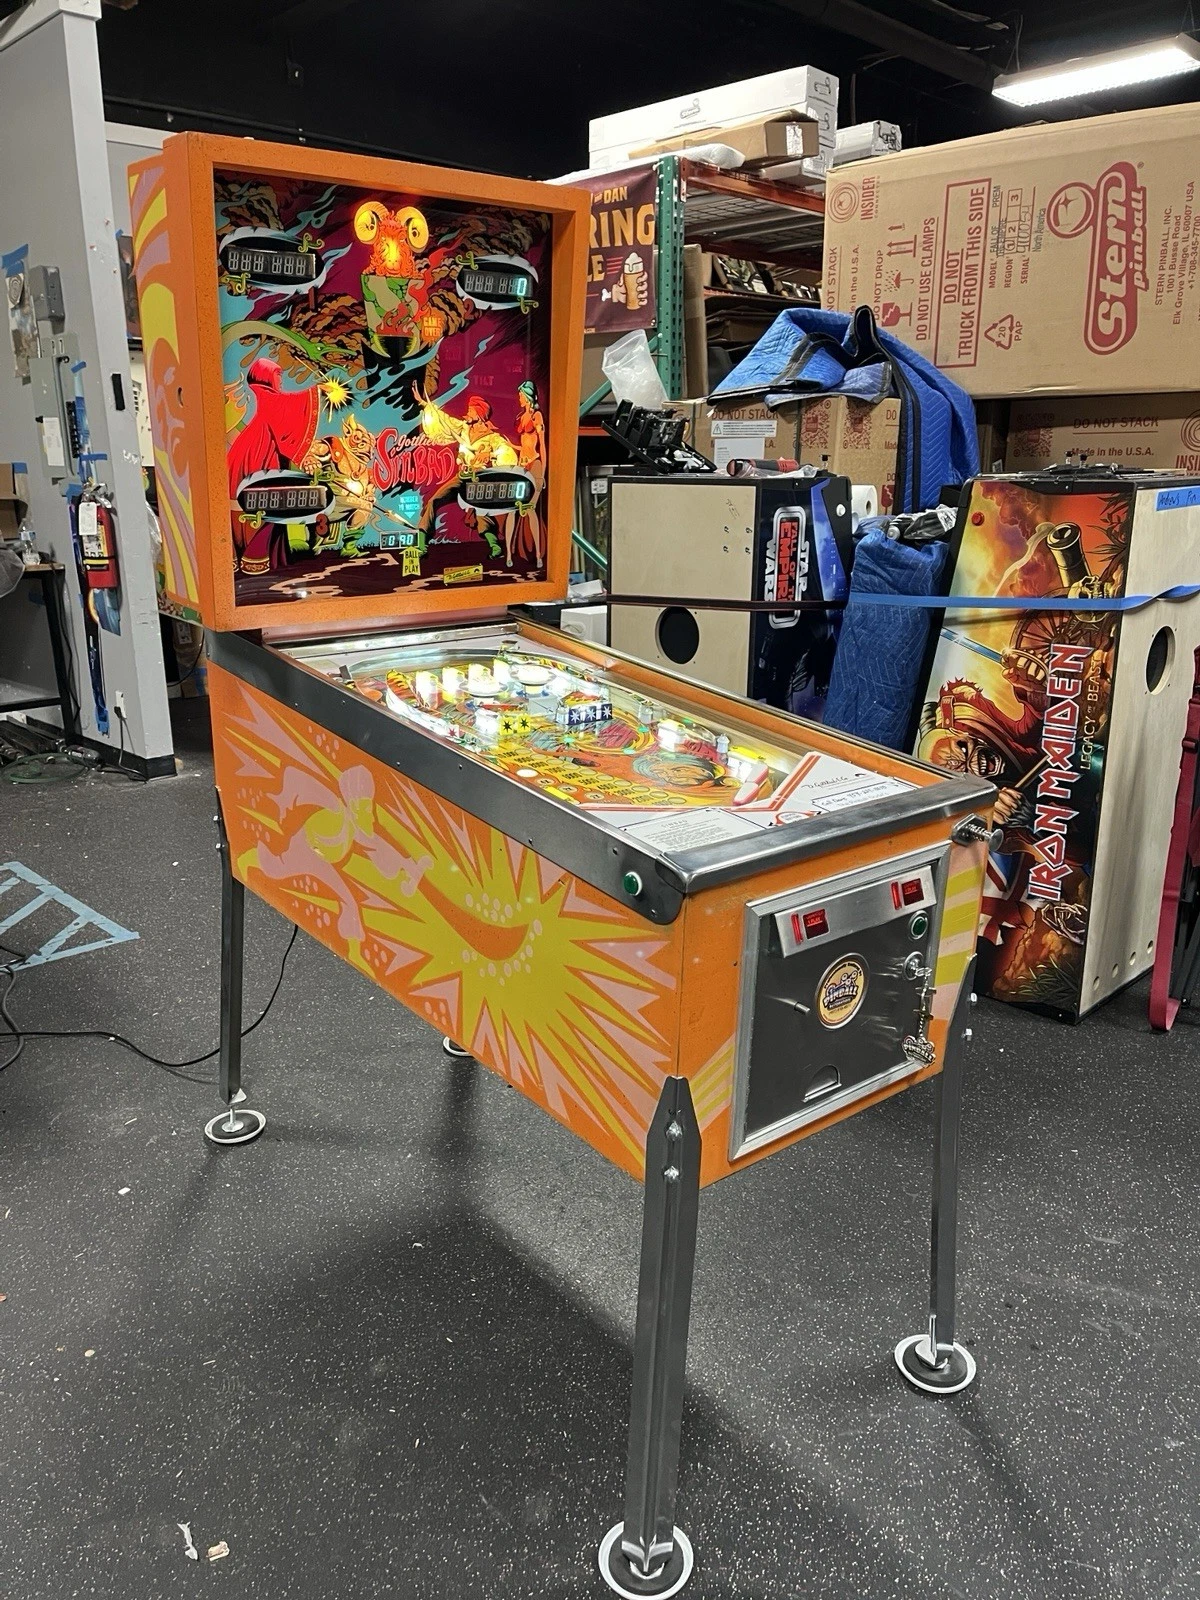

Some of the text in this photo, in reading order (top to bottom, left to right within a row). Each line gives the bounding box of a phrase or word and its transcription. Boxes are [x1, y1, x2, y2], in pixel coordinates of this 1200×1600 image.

[603, 185, 628, 203] DAN
[860, 175, 876, 221] INSIDER
[992, 185, 1001, 208] PREM
[1010, 194, 1019, 202] 3
[1032, 208, 1047, 253] North America
[1129, 188, 1147, 290] pinball
[852, 244, 860, 274] U.S.A.
[875, 250, 884, 278] DROP
[1098, 185, 1127, 336] Stern
[1154, 274, 1166, 306] STERN
[1164, 205, 1173, 227] INC.
[1166, 215, 1182, 294] 1001 Busse Road
[1172, 181, 1195, 325] Elk Grove Village, IL 60007 USA
[828, 246, 838, 287] STACK
[943, 250, 960, 304] DO NOT
[958, 186, 985, 358] TRUCK FROM THIS SIDE
[517, 277, 528, 296] 0
[850, 277, 858, 293] the
[916, 217, 936, 341] DO NOT USE CLAMPS
[850, 294, 857, 302] in
[874, 280, 883, 302] NOT
[464, 297, 475, 320] 2
[424, 327, 442, 337] OVER
[998, 326, 1006, 338] 20
[1014, 321, 1023, 342] PAP
[473, 375, 495, 386] TILT
[712, 408, 779, 420] DO NOT STACK
[885, 409, 897, 420] DO
[1073, 416, 1160, 429] DO NOT STACK
[1071, 447, 1155, 457] Made in the U.S.A.
[516, 481, 526, 499] 0
[316, 513, 328, 535] 3
[465, 508, 477, 527] 4
[404, 550, 418, 559] BALL
[778, 521, 792, 601] EMPIR
[800, 540, 810, 592] STAR
[404, 565, 419, 573] PLAY
[789, 561, 797, 581] OF
[1087, 659, 1102, 702] BEAST
[1036, 643, 1095, 800] MAIDEN
[1080, 715, 1096, 770] LEGACY
[1028, 803, 1080, 901] IRON
